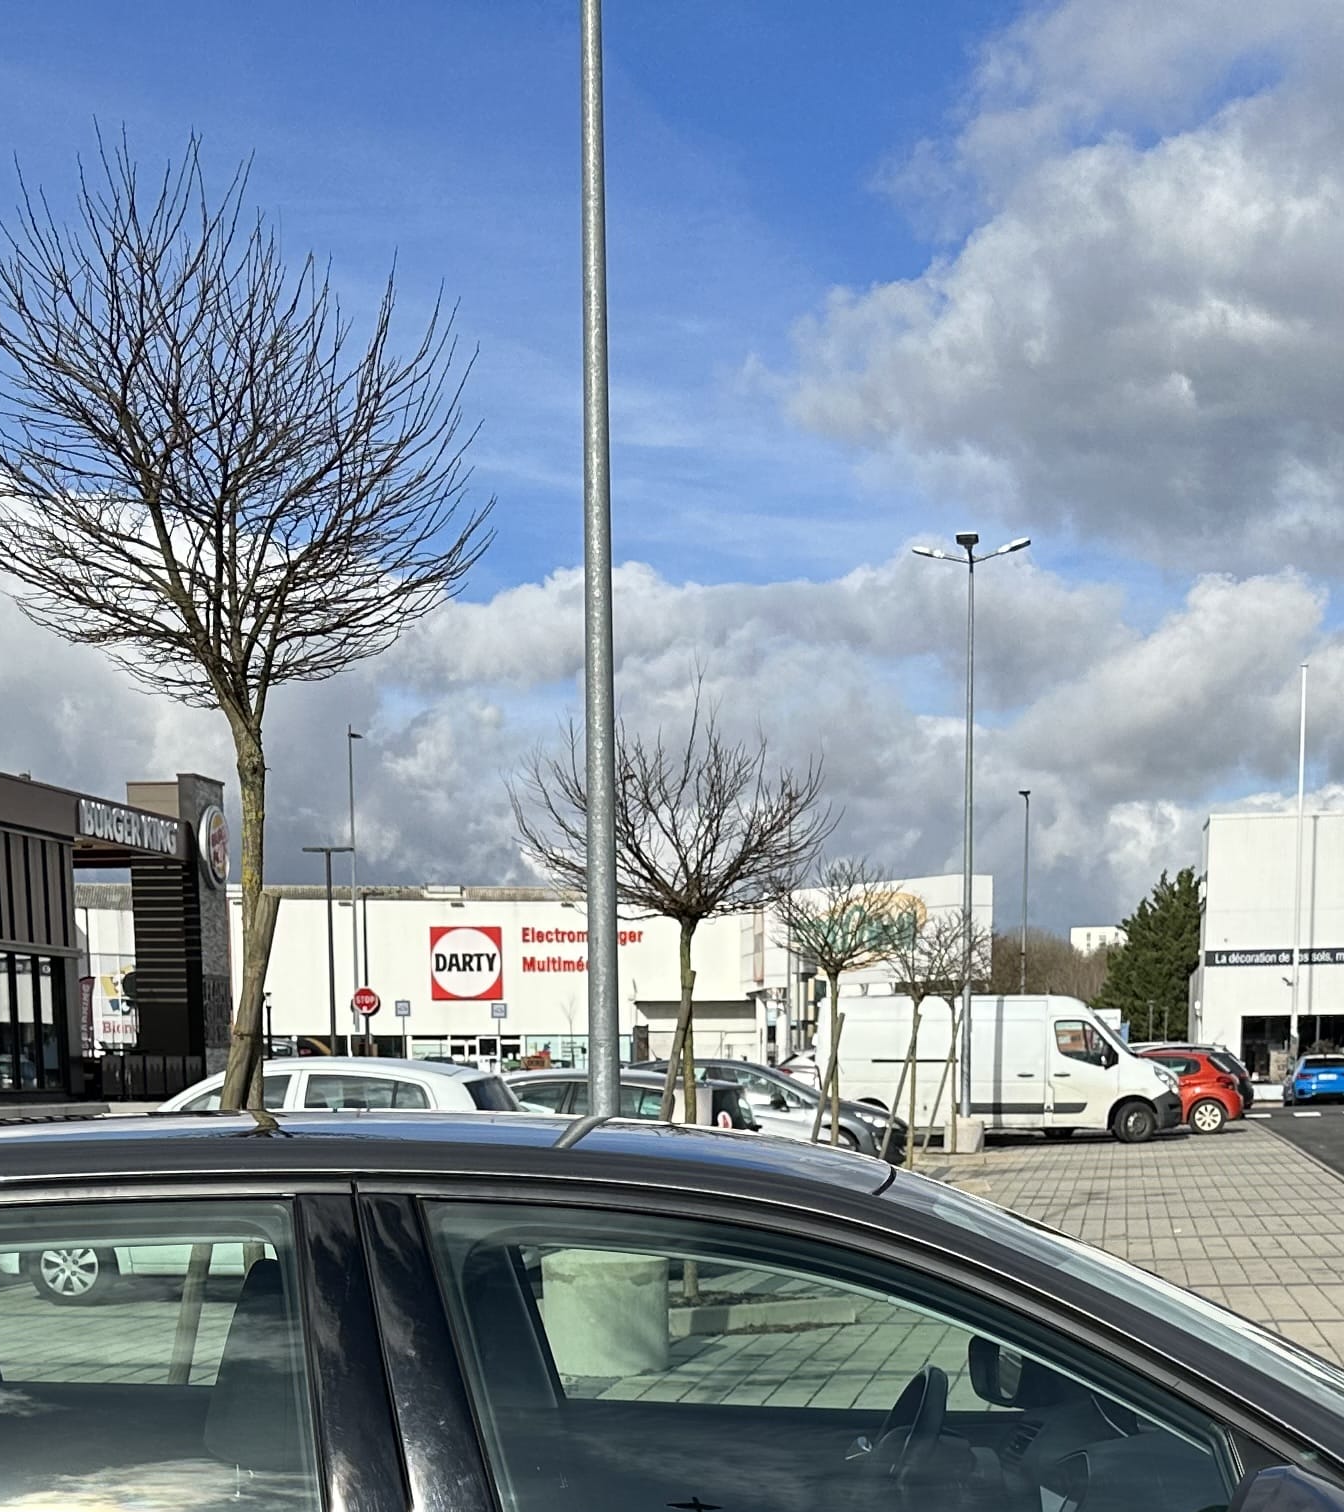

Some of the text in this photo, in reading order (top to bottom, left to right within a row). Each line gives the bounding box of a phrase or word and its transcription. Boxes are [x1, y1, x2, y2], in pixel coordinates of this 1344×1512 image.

[79, 799, 141, 846] BURGER
[141, 815, 178, 855] KING
[522, 927, 643, 945] Electromger
[434, 953, 497, 972] DARTY
[522, 957, 588, 972] Multimé
[1215, 952, 1226, 964] La
[1228, 951, 1277, 963] décoration
[1279, 951, 1290, 963] de
[356, 994, 376, 1005] STOP
